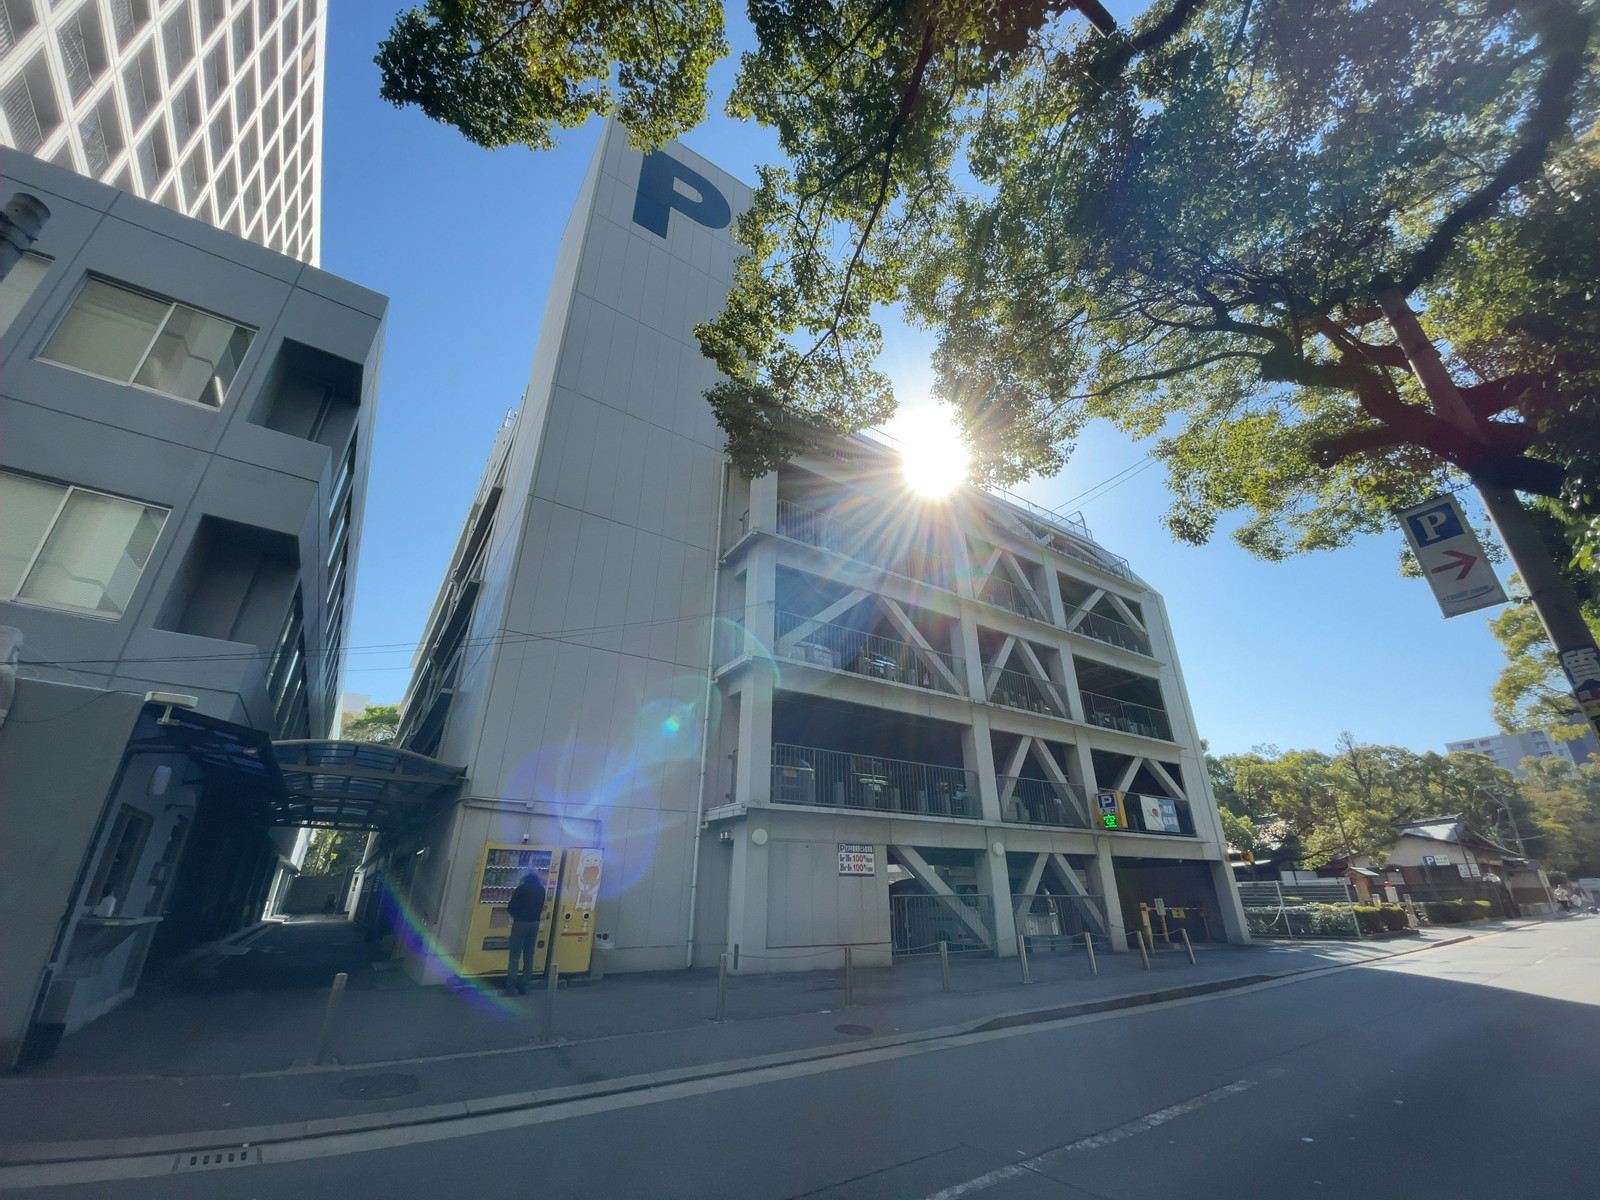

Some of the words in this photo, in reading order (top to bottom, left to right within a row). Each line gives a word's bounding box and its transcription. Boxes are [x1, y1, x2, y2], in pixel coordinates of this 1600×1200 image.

[632, 144, 731, 240] P
[1416, 511, 1447, 542] P
[1101, 795, 1113, 808] P
[1103, 814, 1117, 828] 空
[1426, 856, 1434, 865] P
